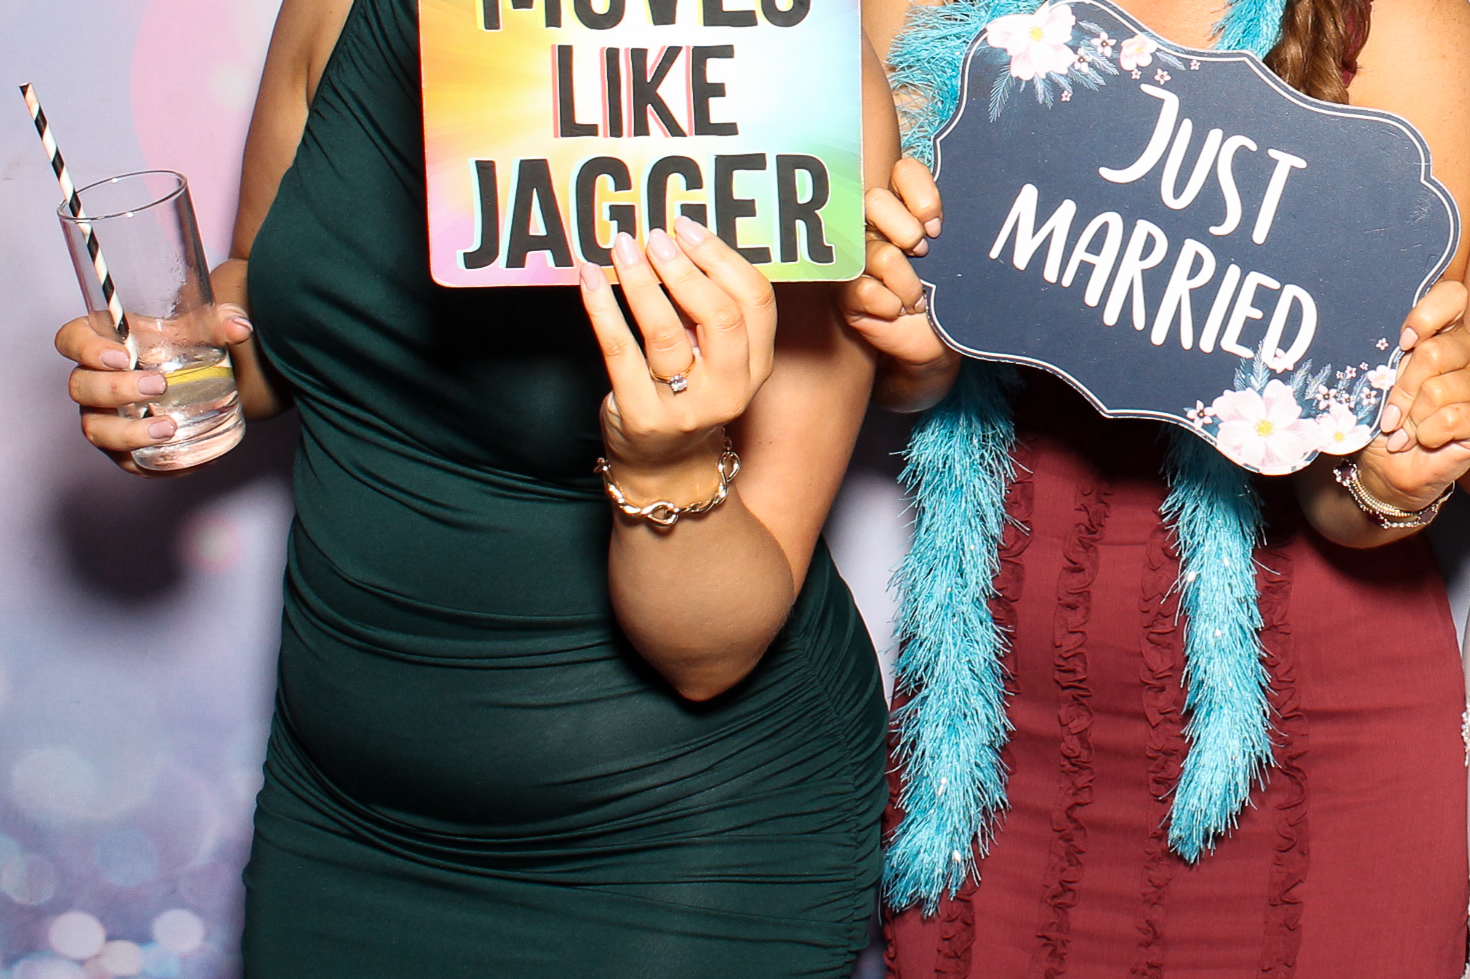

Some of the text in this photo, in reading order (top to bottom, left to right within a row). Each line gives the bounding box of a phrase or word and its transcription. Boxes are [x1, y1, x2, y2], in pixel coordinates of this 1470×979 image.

[551, 44, 739, 139] LIKE
[457, 152, 836, 271] JAGGER
[1098, 83, 1308, 245] JUST
[989, 183, 1318, 374] MARRIED
